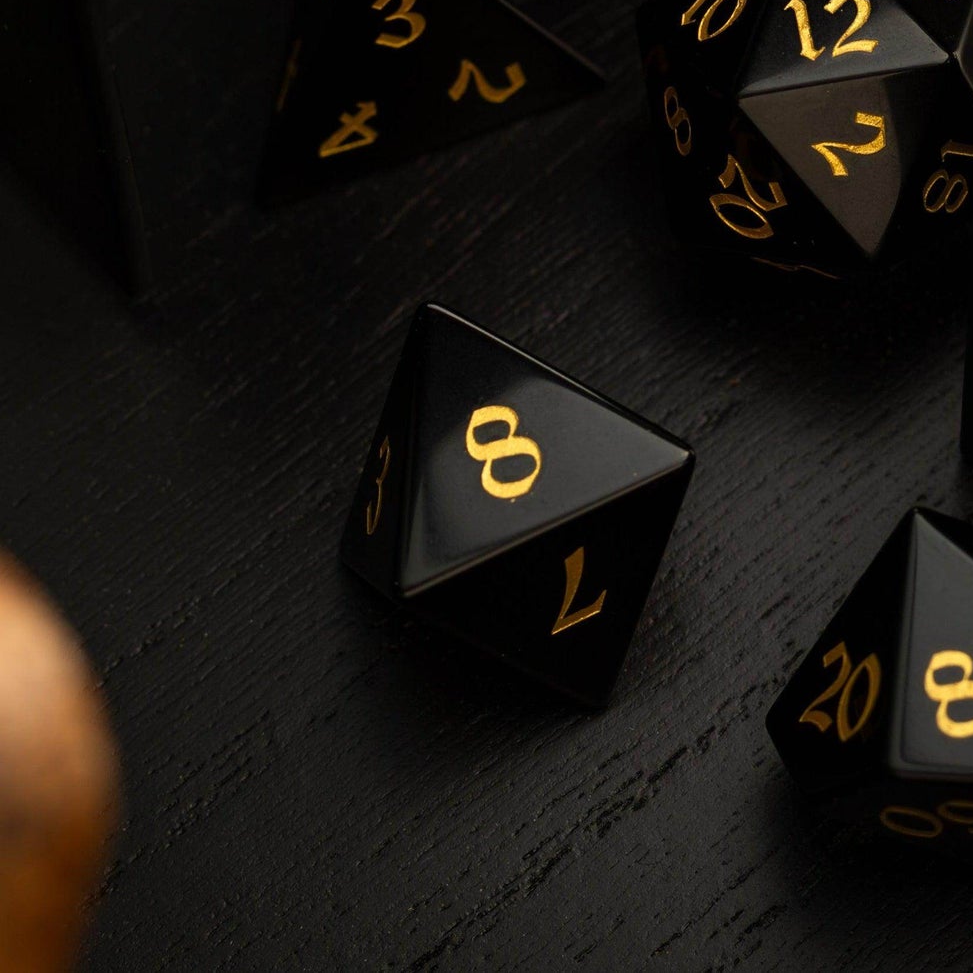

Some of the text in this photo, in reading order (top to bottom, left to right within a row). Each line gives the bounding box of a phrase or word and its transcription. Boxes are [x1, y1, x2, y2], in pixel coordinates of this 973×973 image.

[448, 59, 527, 104] 2
[318, 100, 378, 159] 4
[812, 111, 888, 178] 2
[709, 154, 788, 240] 20
[464, 404, 544, 503] 8
[551, 547, 607, 635] 7
[799, 641, 882, 742] 20
